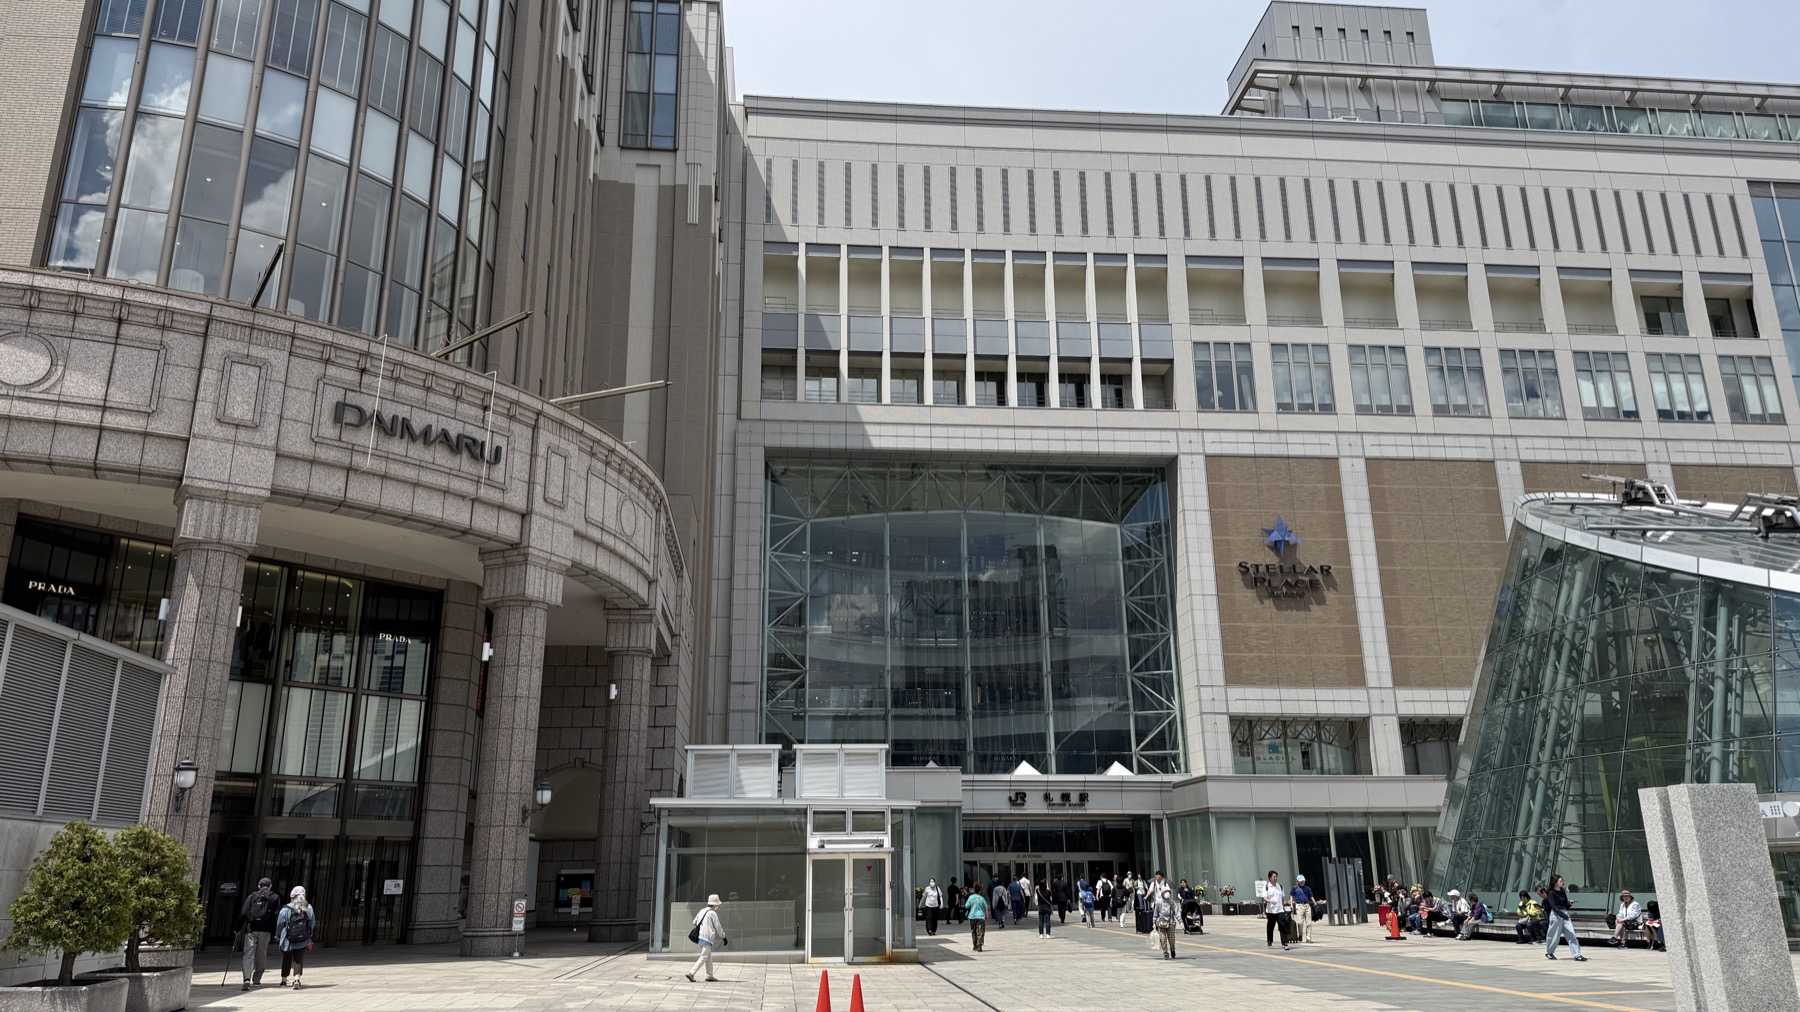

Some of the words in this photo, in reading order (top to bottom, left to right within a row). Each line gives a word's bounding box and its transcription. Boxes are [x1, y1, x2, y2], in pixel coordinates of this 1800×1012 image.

[334, 400, 502, 465] DAIMARU
[1238, 561, 1332, 574] STELLAR
[28, 580, 75, 596] PRADA
[1253, 576, 1321, 589] PLACE
[379, 632, 412, 644] PRADA
[1008, 792, 1027, 803] JR
[1043, 792, 1090, 803] 札幌駅
